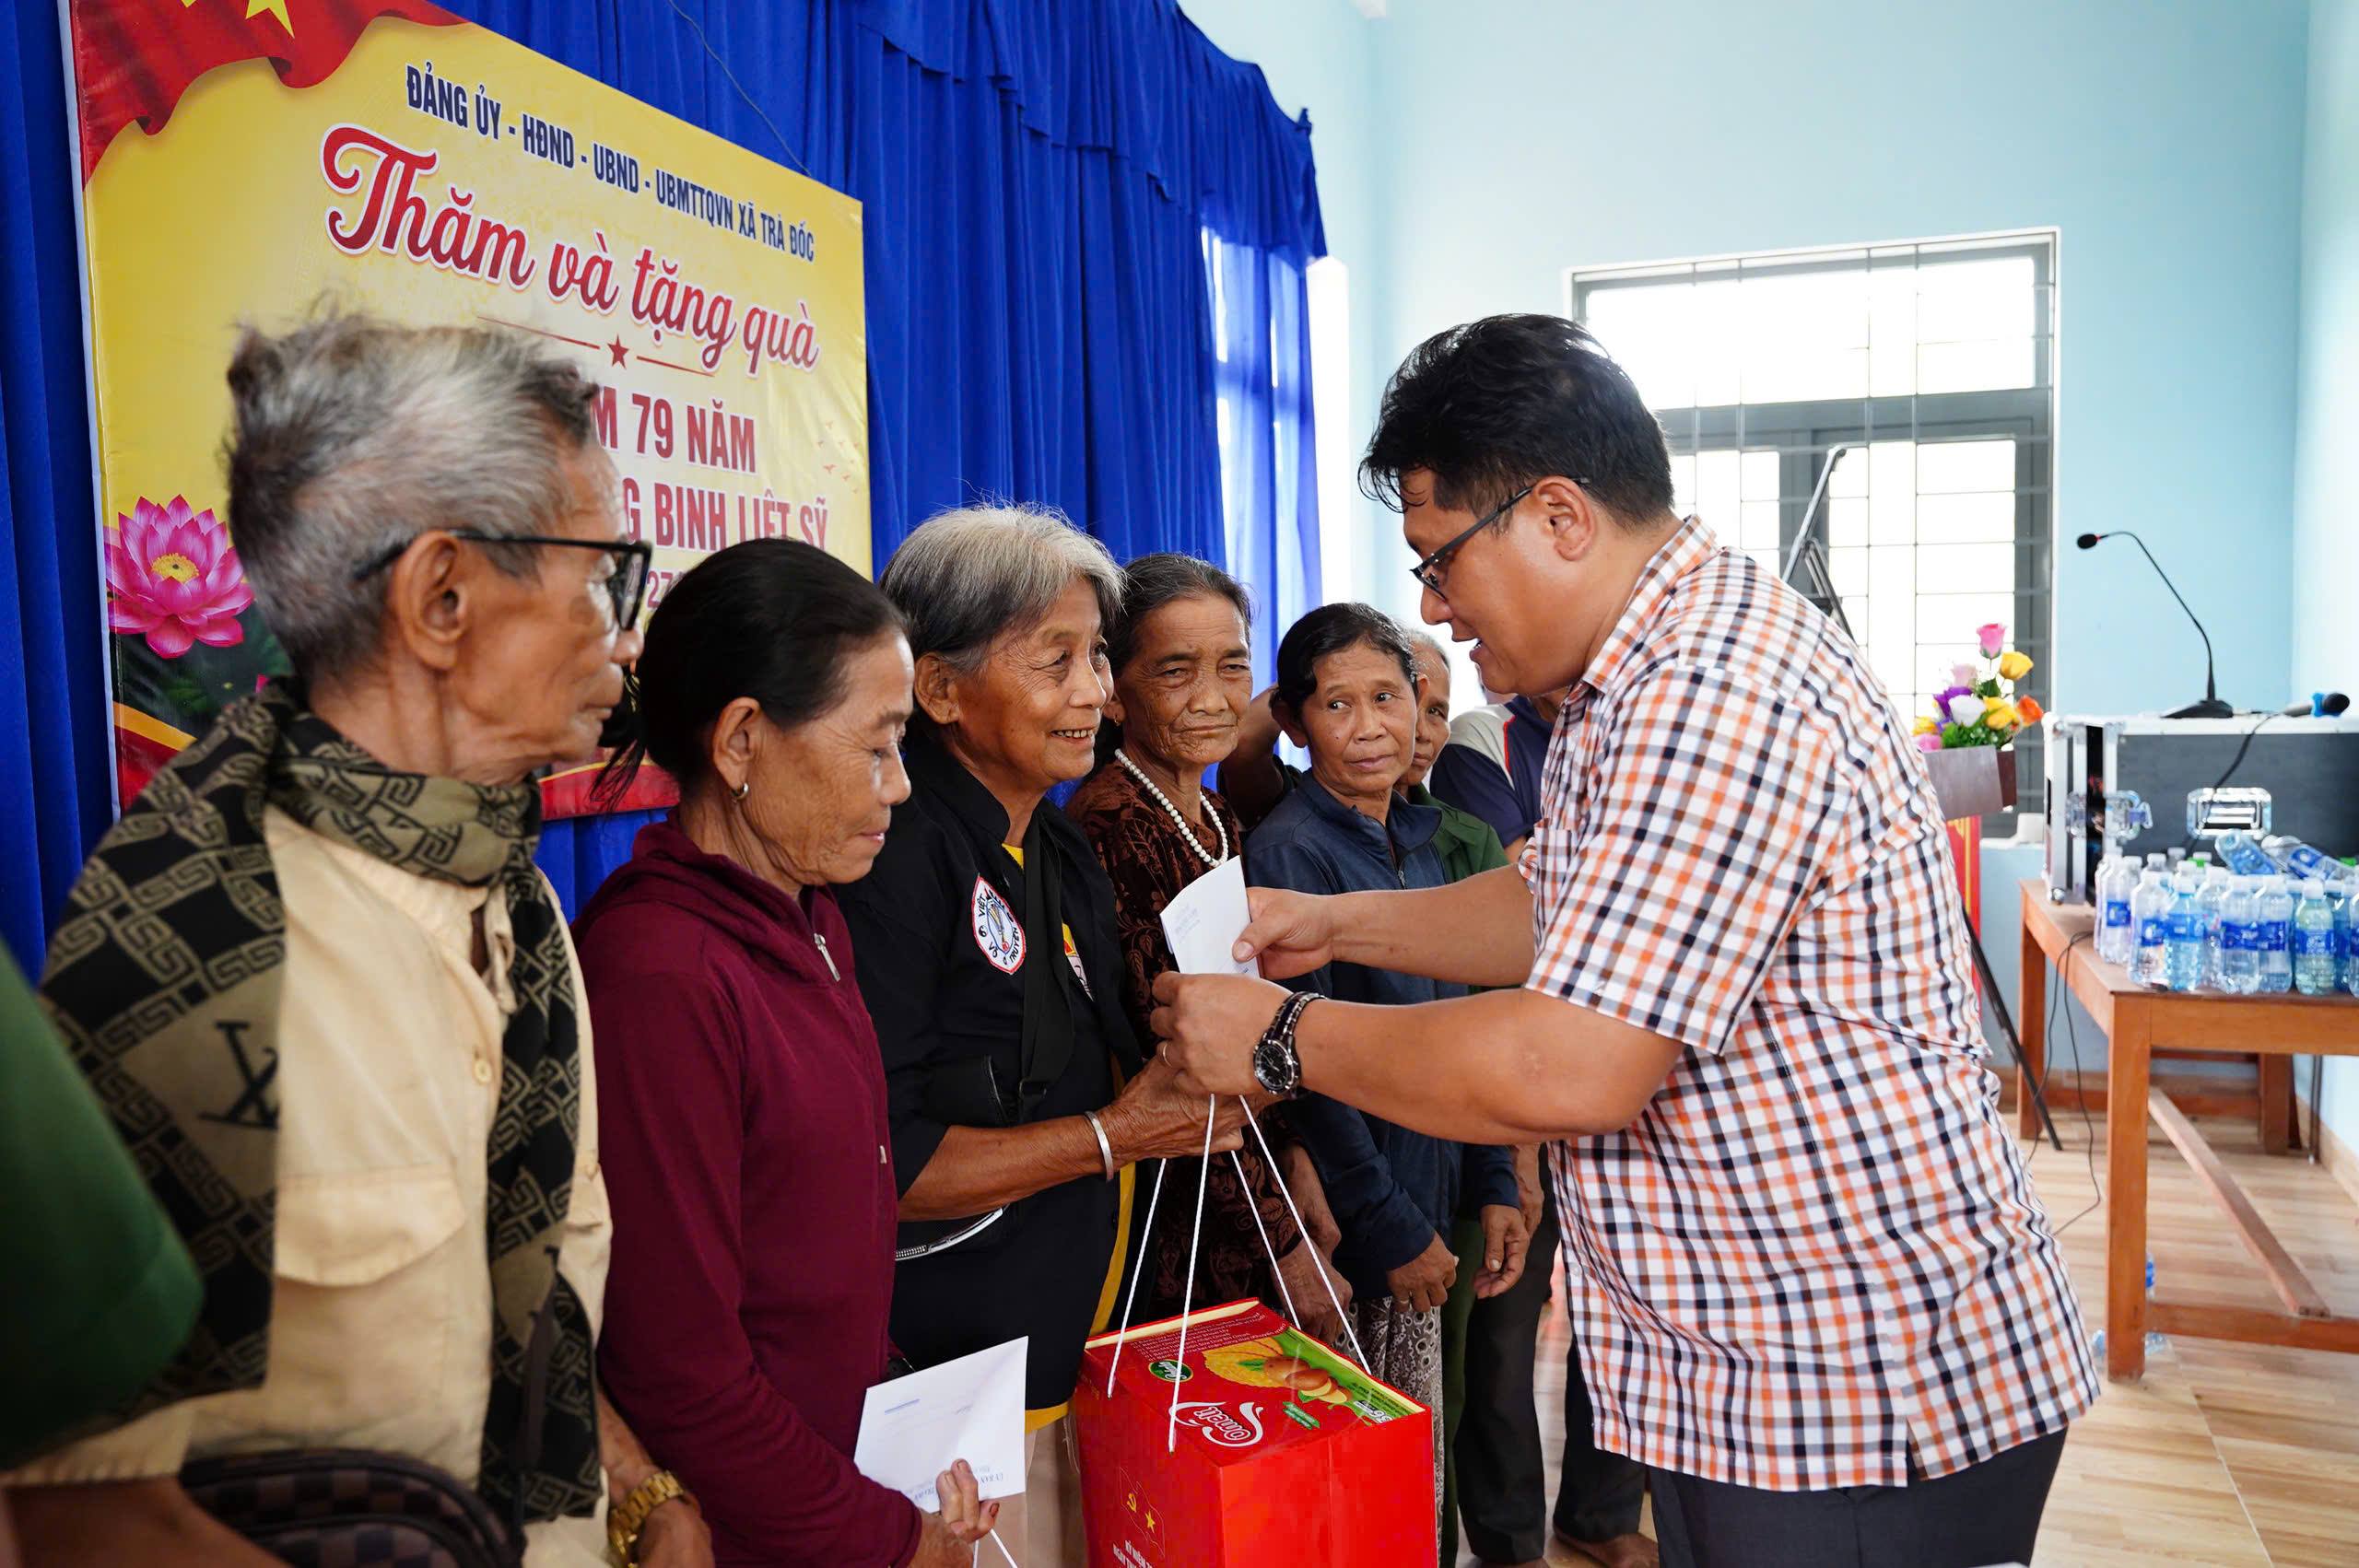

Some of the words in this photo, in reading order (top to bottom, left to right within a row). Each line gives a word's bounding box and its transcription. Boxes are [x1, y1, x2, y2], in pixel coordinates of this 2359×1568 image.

[406, 62, 468, 128] ĐẢNG
[475, 84, 501, 139] ỦY
[522, 113, 574, 169] HĐND
[593, 143, 640, 193] UBND
[656, 170, 734, 230] UBMTTQVN
[738, 202, 757, 240] XÃ
[760, 212, 785, 251] TRÀ
[790, 221, 814, 262] ĐỐC
[323, 126, 535, 287] Thăm
[551, 231, 618, 309] và
[631, 249, 736, 369] tặng
[744, 303, 818, 375] quà
[632, 392, 674, 458] 79
[687, 398, 756, 473] NĂM
[654, 483, 727, 551] BINH
[800, 497, 827, 552] SỸ
